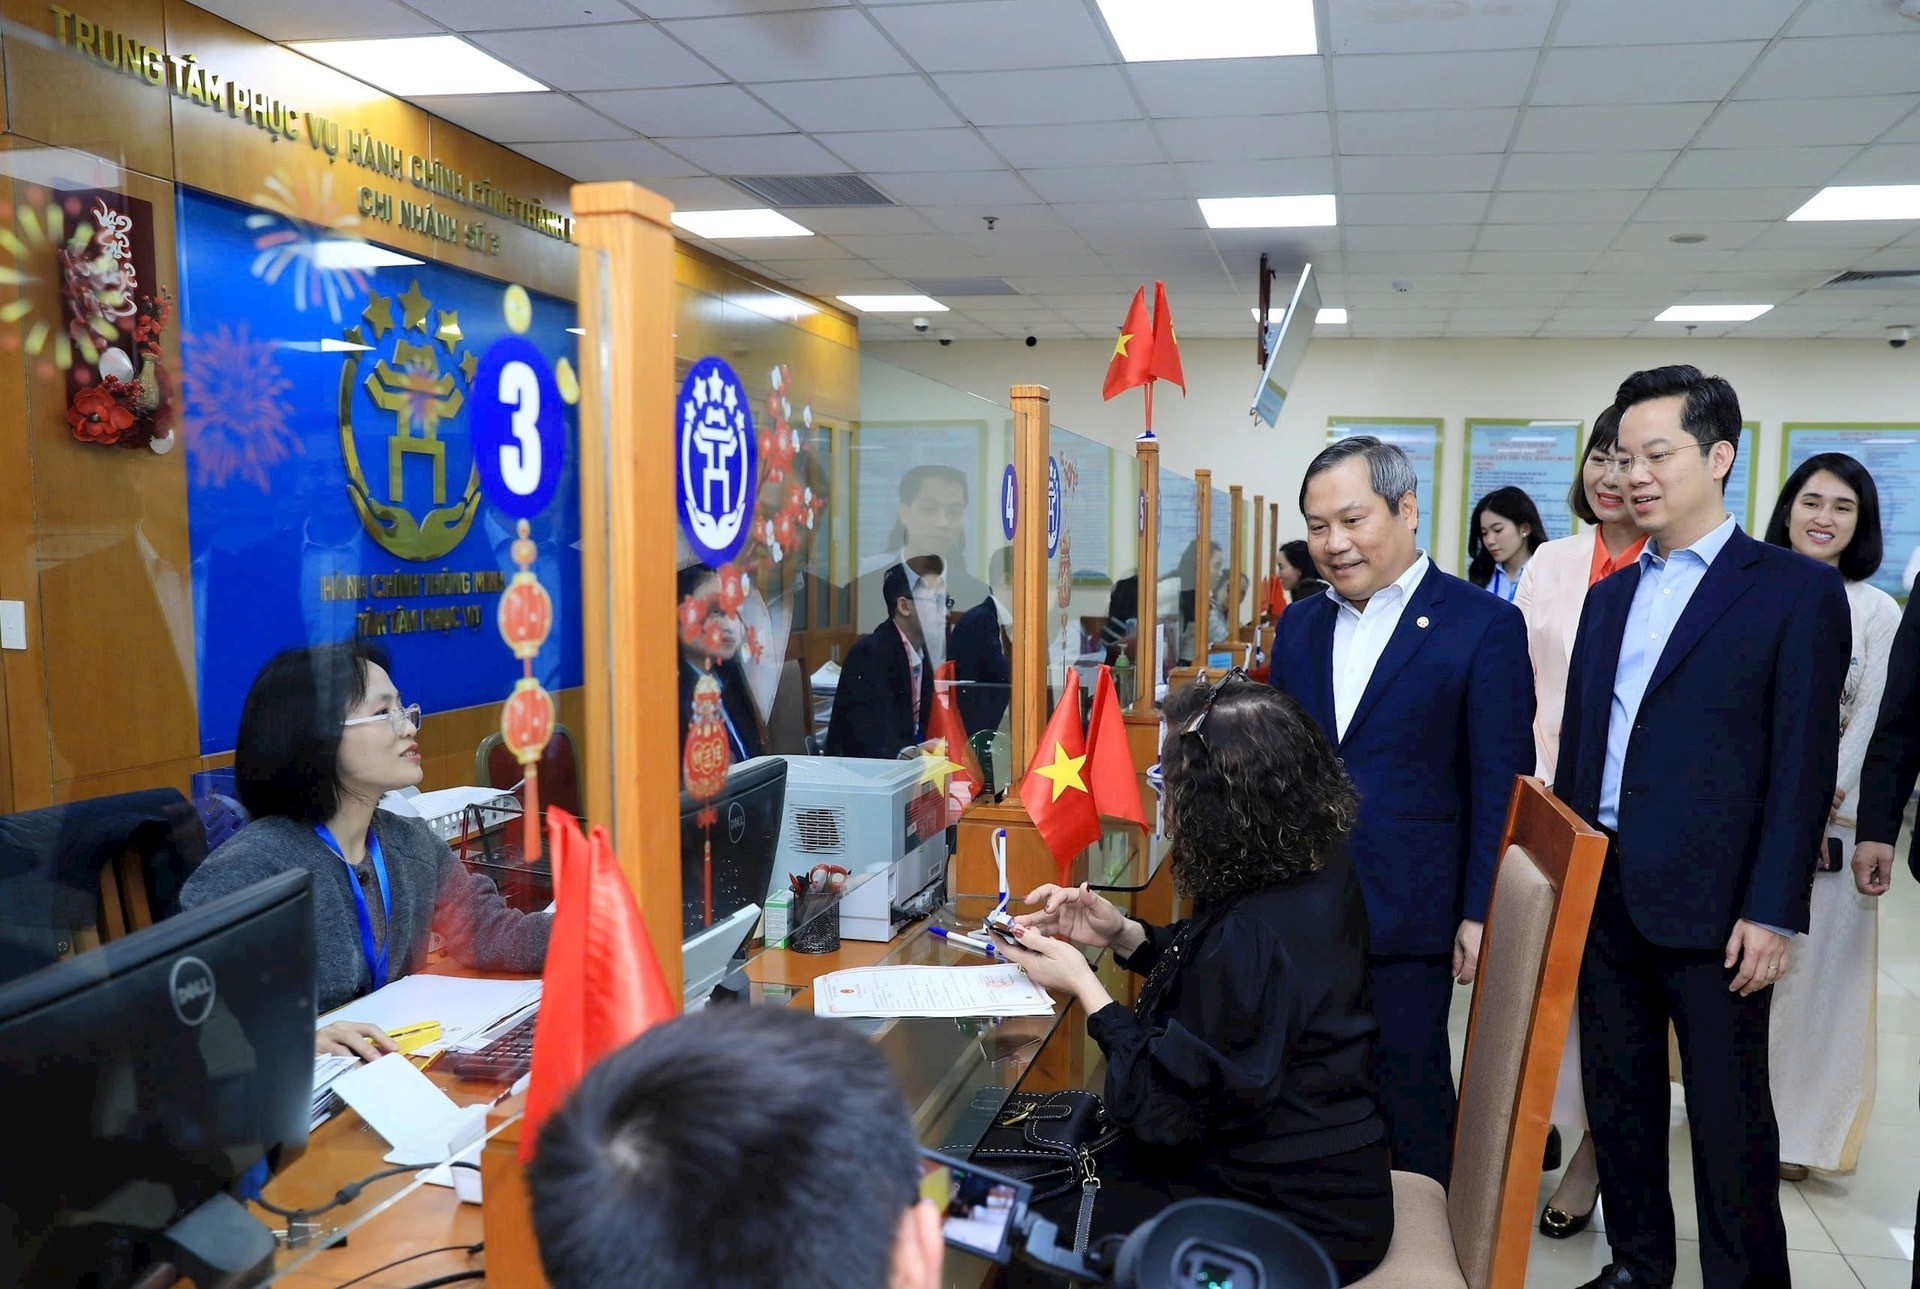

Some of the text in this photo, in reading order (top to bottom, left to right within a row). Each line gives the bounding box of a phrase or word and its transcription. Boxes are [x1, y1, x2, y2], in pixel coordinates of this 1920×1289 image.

[50, 5, 164, 87] TRUNG
[168, 53, 225, 111] TÂM
[227, 81, 301, 143] PHỤC
[304, 112, 339, 165] VỤ
[345, 127, 403, 181] HÀNH
[408, 154, 465, 199] CHÍNH
[468, 176, 514, 218] CÔNG
[516, 198, 566, 239] THÀNH
[357, 185, 393, 224] CHI
[398, 201, 459, 243] NHÁNH
[498, 360, 543, 496] 3
[1006, 474, 1014, 528] 4
[320, 570, 369, 601] HÀNH
[370, 567, 421, 598] CHÍNH
[422, 566, 472, 597] THÔNG
[463, 604, 482, 632] VỤ
